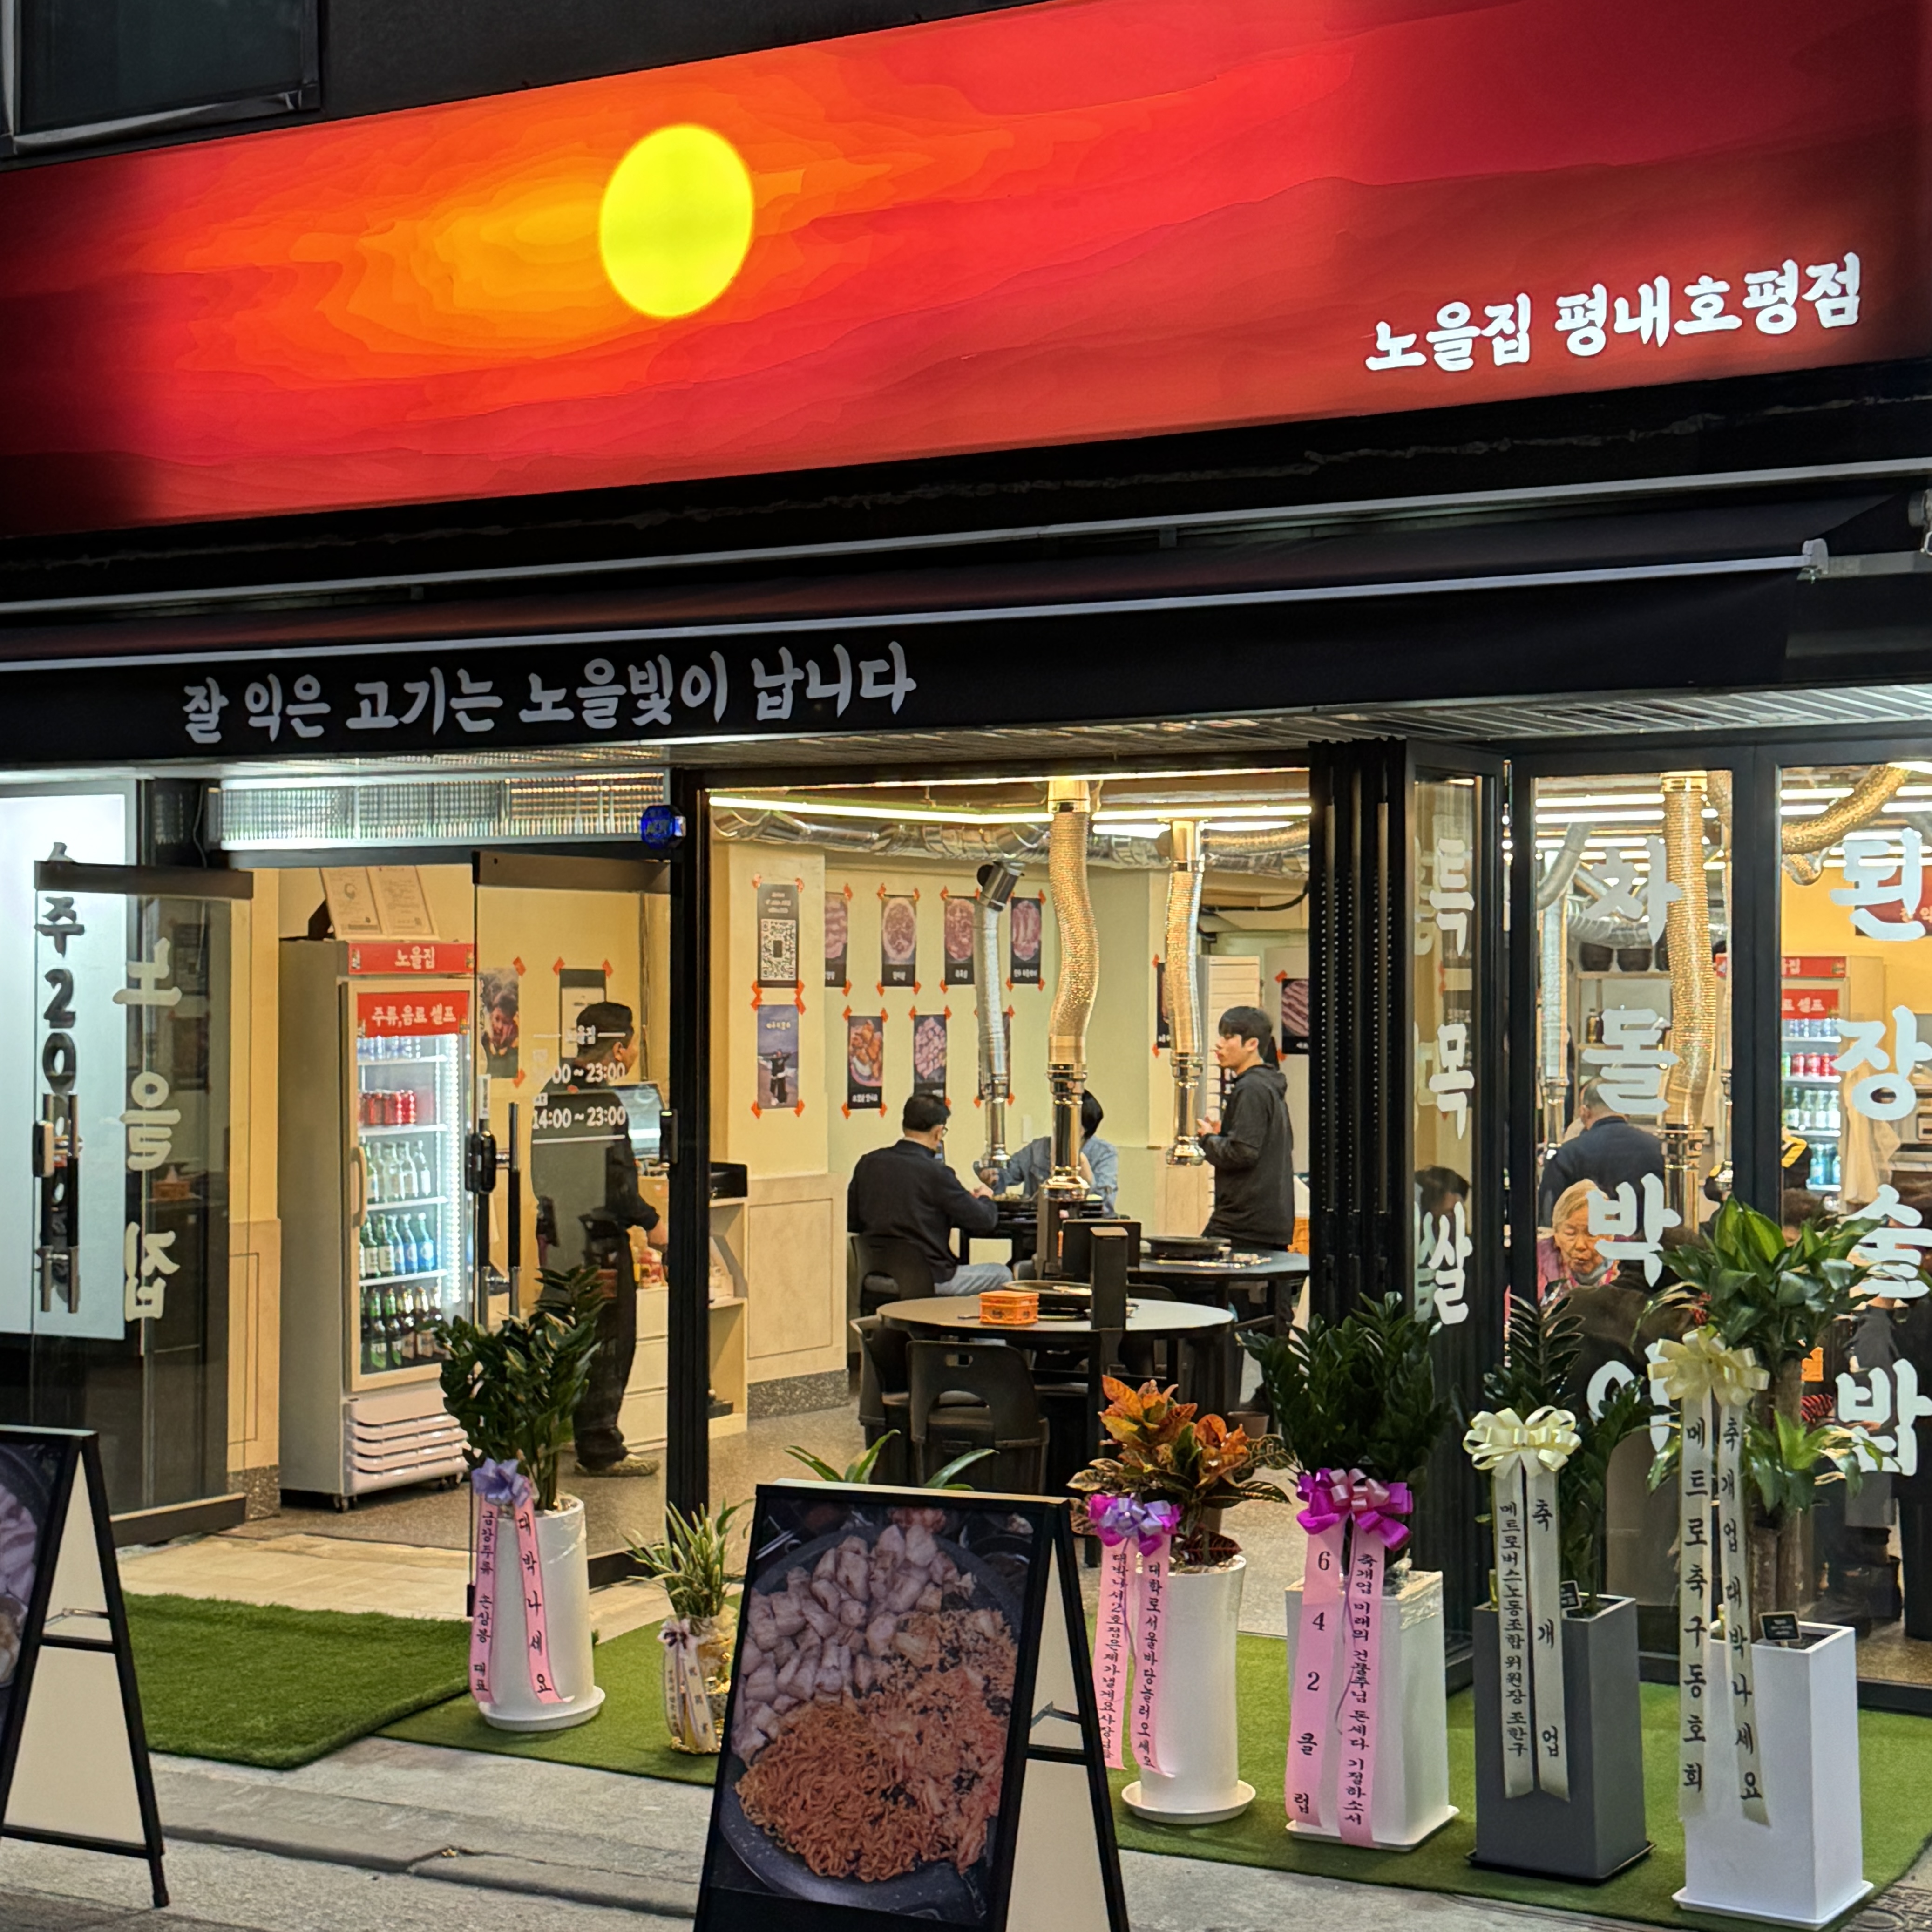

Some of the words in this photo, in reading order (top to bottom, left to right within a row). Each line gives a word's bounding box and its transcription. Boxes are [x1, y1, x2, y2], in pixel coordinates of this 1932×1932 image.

[1365, 293, 1532, 372] 노을집
[1554, 251, 1861, 358] 평내호평점
[182, 676, 230, 745] 잘
[244, 673, 332, 742] 익은
[346, 666, 503, 737] 고기는
[519, 651, 729, 729] 노을빛이
[751, 641, 917, 721] 납니다
[395, 946, 435, 970] 노을집
[372, 1004, 427, 1028] 주류,음료
[430, 1003, 457, 1025] 셀프
[532, 1108, 571, 1129] 14:00
[587, 1106, 626, 1126] 23:00
[1583, 834, 1682, 1453] 차돌박이
[1830, 827, 1932, 1477] 된장술밥
[1683, 1417, 1708, 1792] 메트로축구동호회
